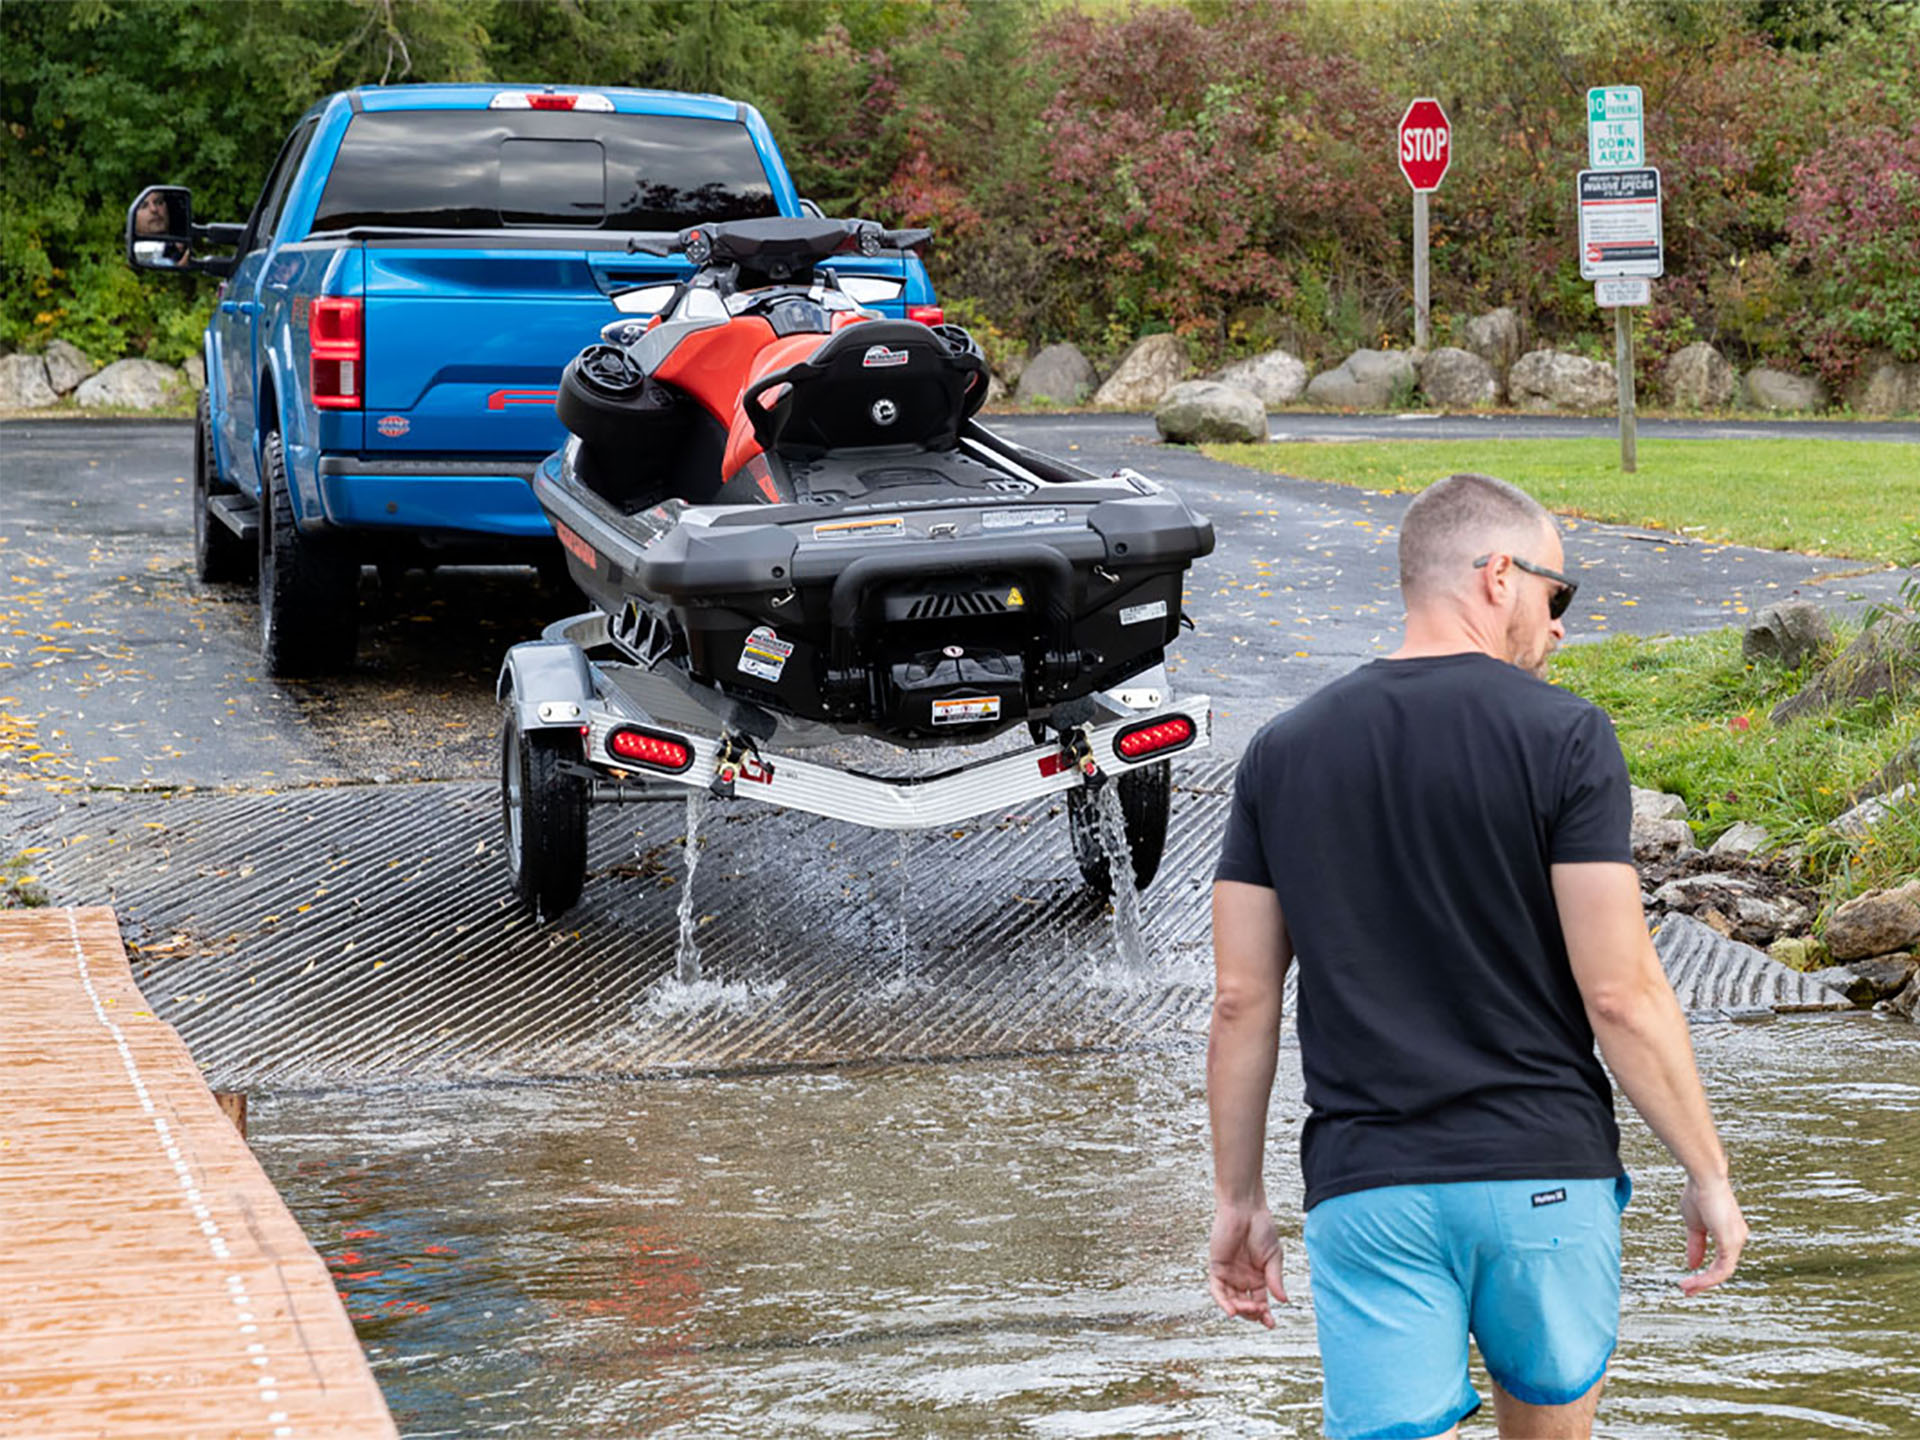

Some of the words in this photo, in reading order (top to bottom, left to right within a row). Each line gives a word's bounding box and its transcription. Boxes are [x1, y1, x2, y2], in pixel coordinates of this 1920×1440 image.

[1590, 97, 1604, 112] 10
[1608, 124, 1624, 135] TIE
[1402, 127, 1447, 162] STOP
[1598, 137, 1635, 149] DOWN
[1598, 149, 1635, 161] AREA
[1621, 179, 1654, 190] SPECIES
